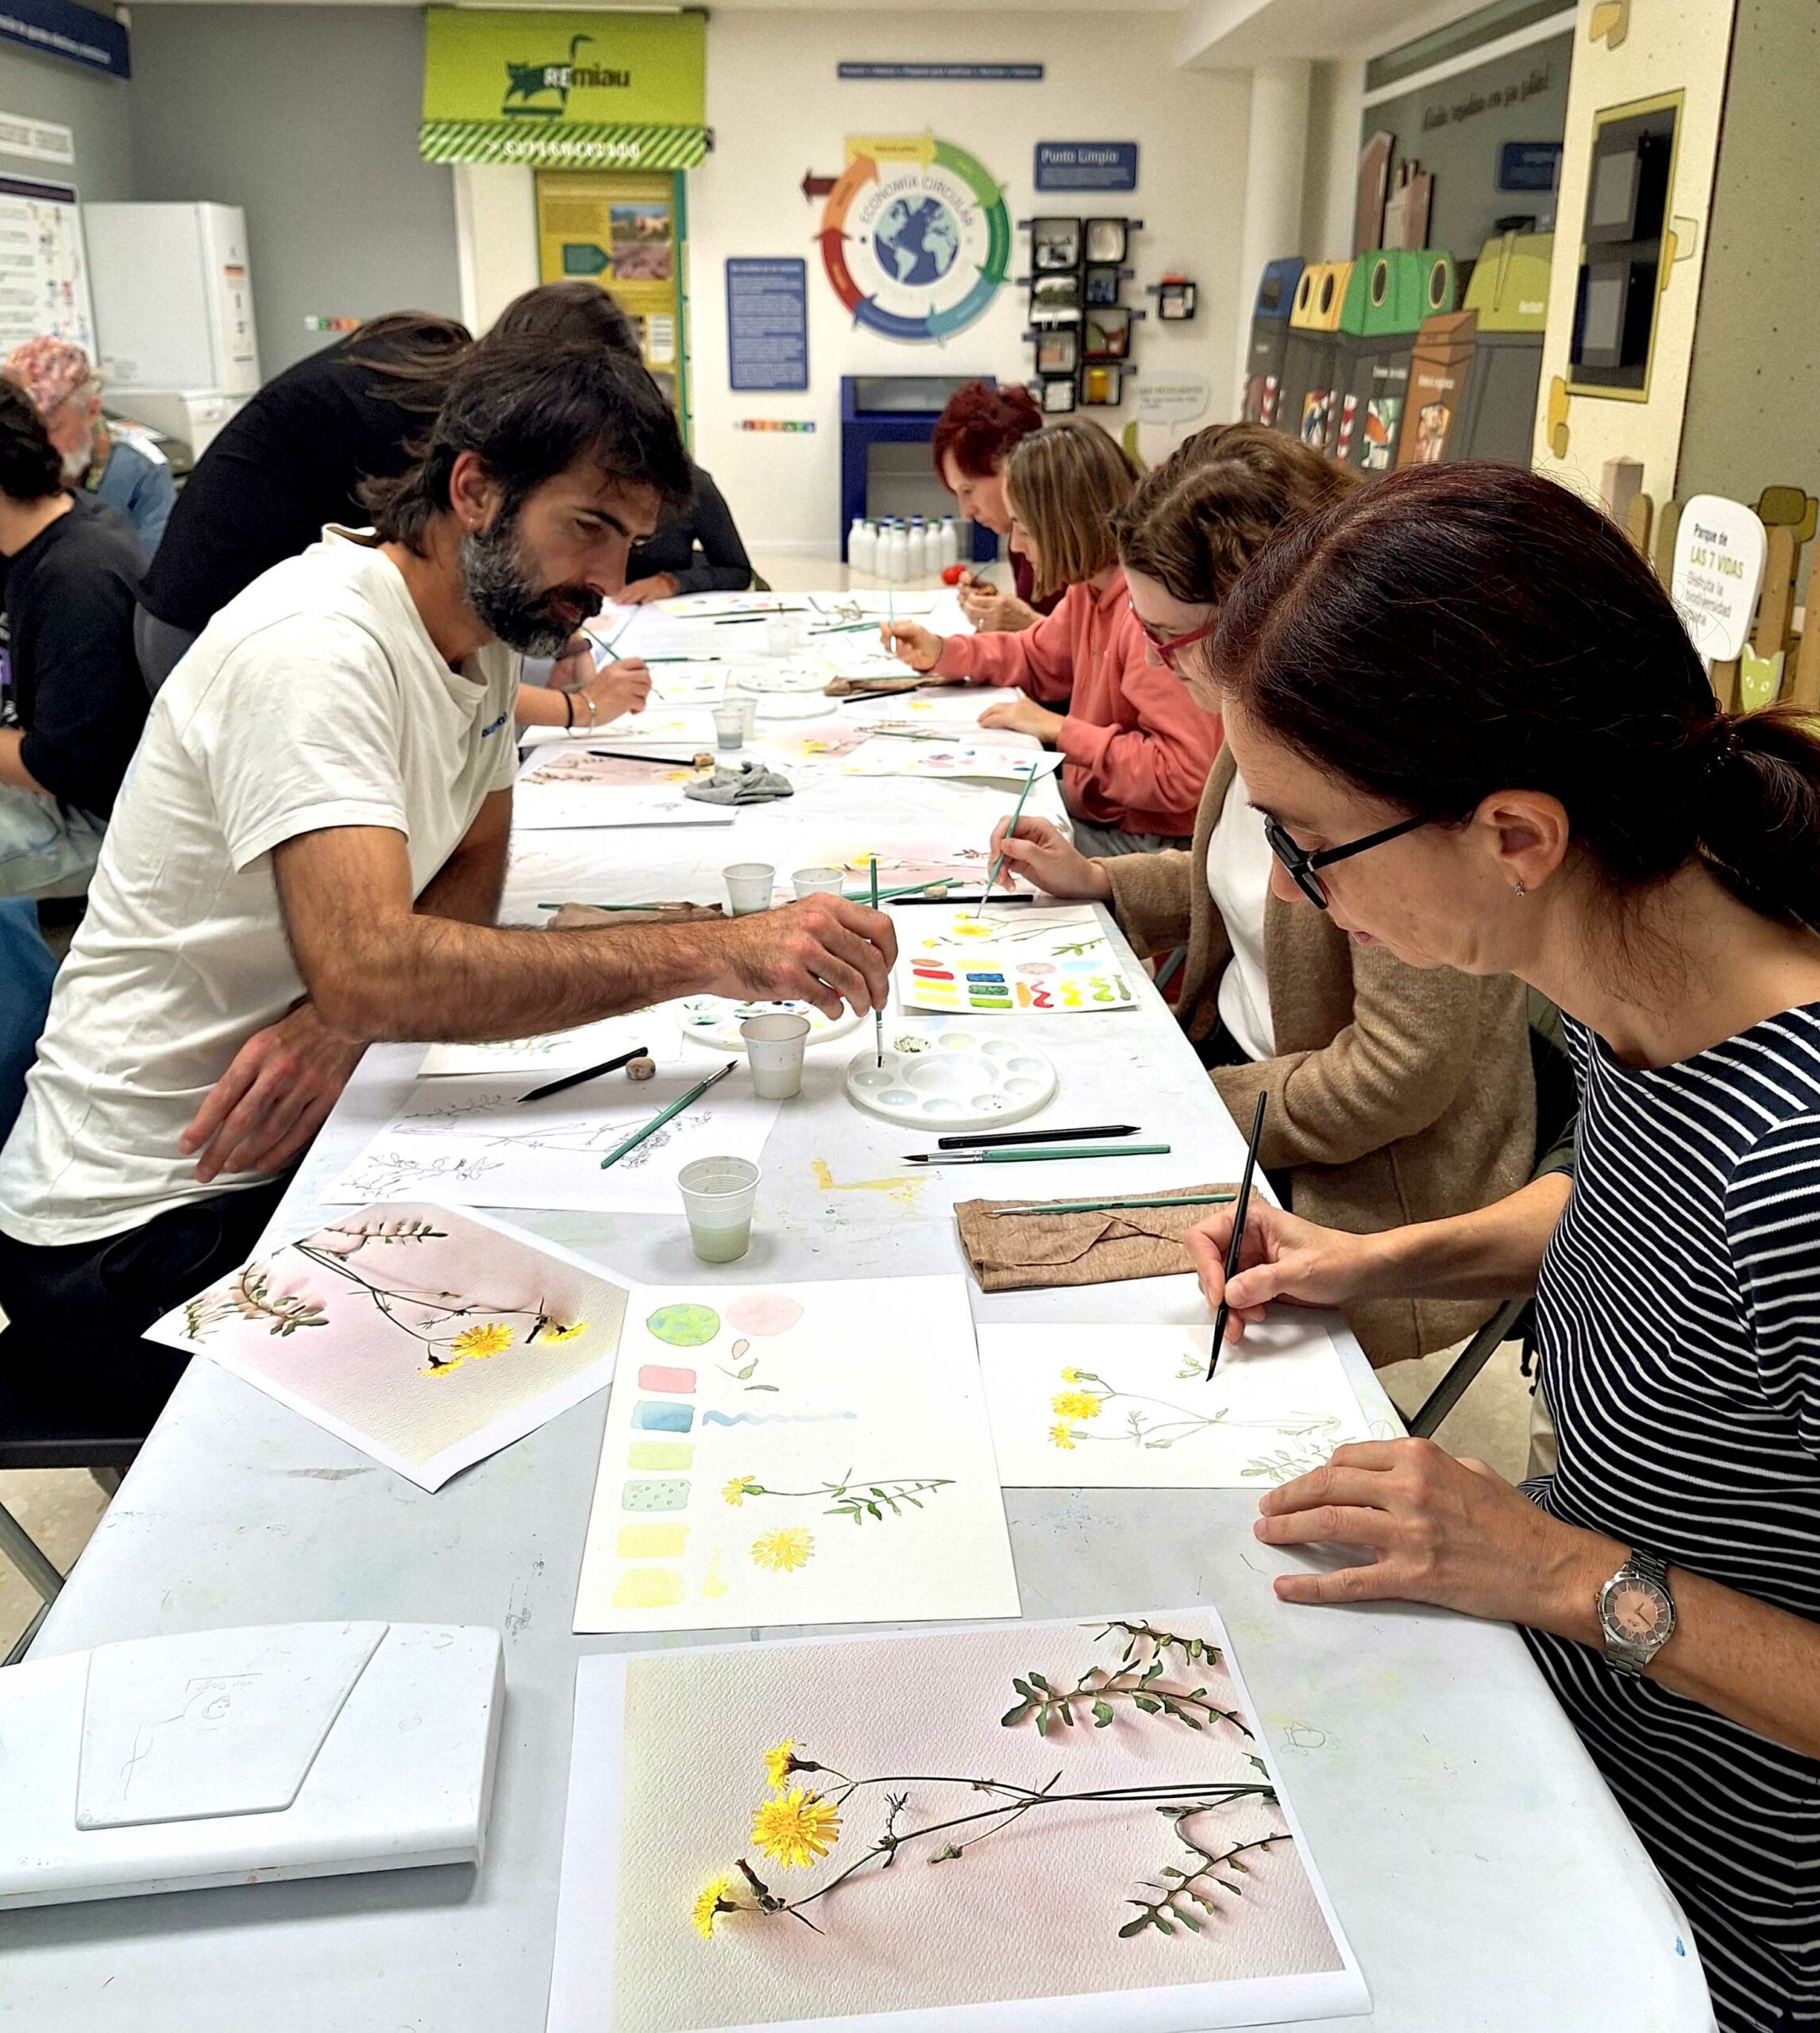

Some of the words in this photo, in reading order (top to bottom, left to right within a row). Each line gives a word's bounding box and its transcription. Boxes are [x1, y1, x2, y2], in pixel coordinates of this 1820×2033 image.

[1041, 148, 1077, 164] Punto
[1078, 148, 1119, 165] Limpio
[1694, 523, 1717, 544] Parque
[1718, 531, 1729, 546] de
[1690, 545, 1707, 566] LAS
[1709, 551, 1716, 569] 7
[1717, 554, 1745, 580] VIDAS
